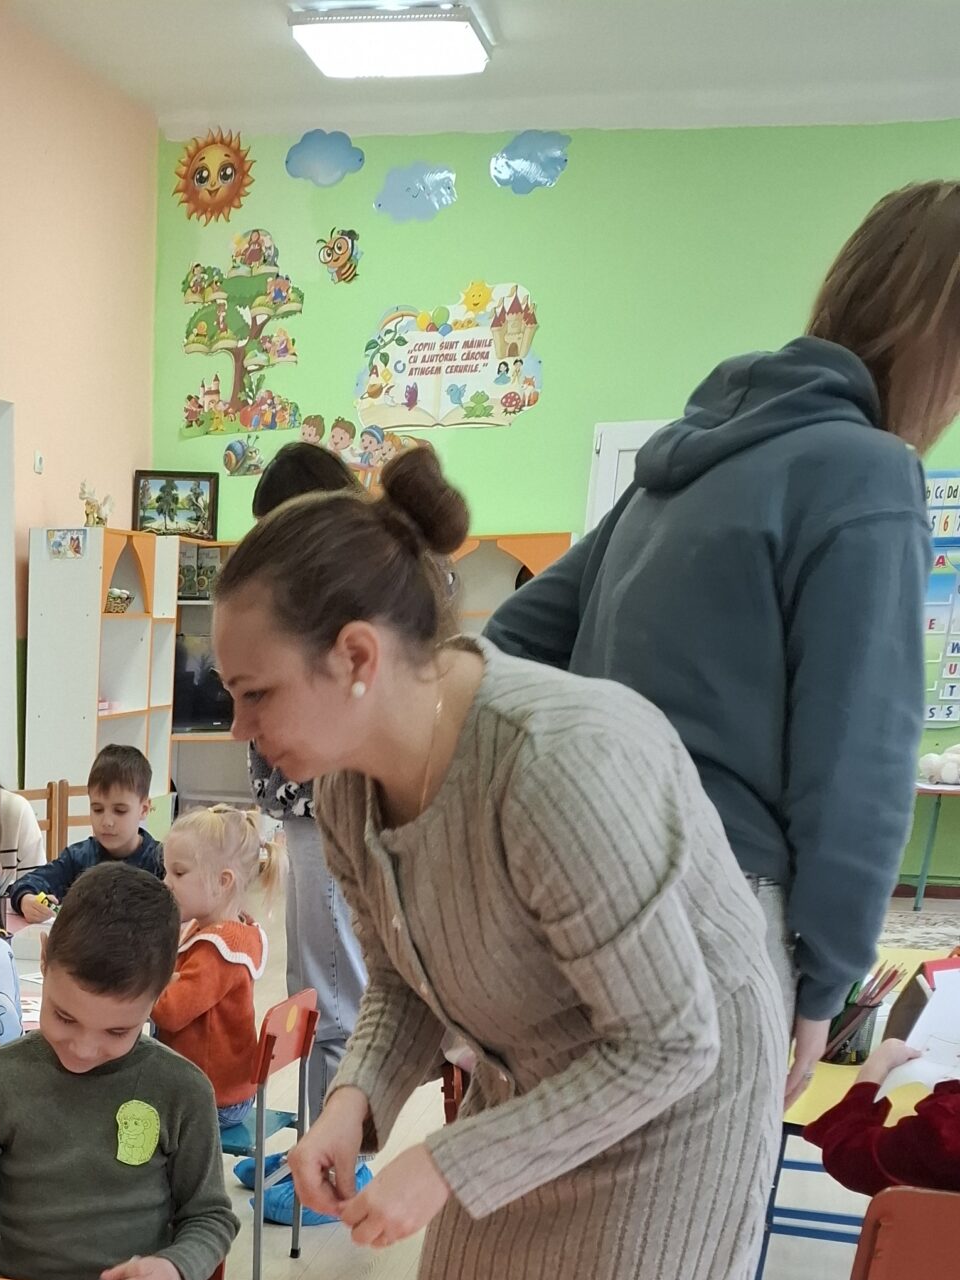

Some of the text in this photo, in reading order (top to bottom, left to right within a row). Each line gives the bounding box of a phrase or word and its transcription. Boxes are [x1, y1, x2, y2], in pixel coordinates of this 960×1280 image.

[439, 341, 460, 351] SUNT
[408, 355, 419, 364] CU
[421, 353, 457, 364] AJUTORUL
[408, 365, 442, 377] ATINGEM
[947, 485, 959, 499] Dd
[943, 515, 950, 532] 6
[935, 555, 946, 567] A
[928, 618, 936, 630] E
[949, 663, 958, 675] U
[949, 684, 957, 697] T
